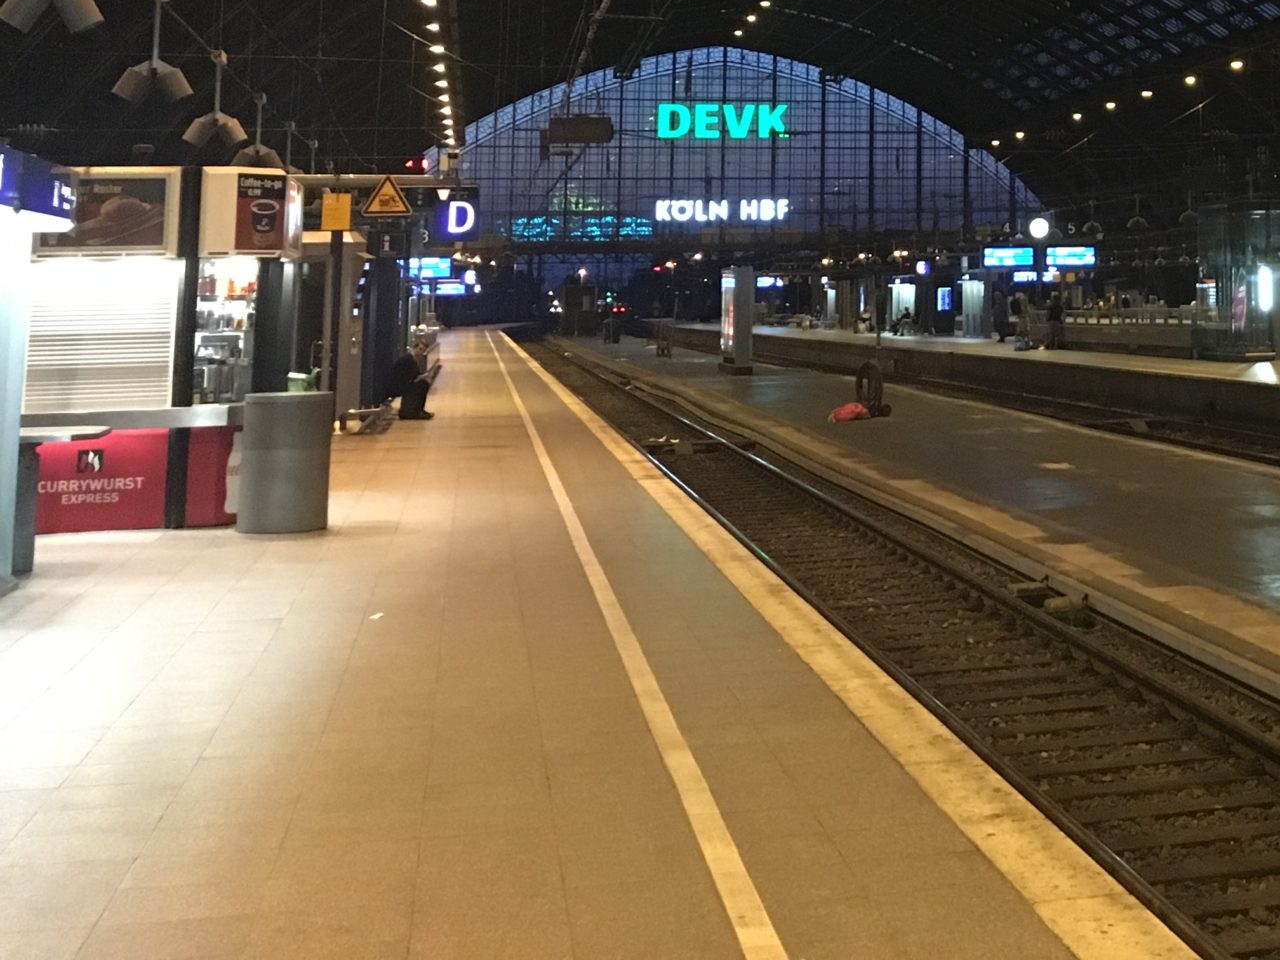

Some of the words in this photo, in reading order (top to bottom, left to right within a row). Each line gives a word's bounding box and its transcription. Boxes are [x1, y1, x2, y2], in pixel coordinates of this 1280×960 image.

[657, 103, 788, 138] DEVK
[447, 201, 475, 234] D
[655, 199, 729, 221] KÖLN
[740, 198, 789, 221] HBF
[1002, 222, 1010, 233] 4
[1067, 223, 1076, 234] 5
[420, 229, 429, 244] 3
[37, 477, 145, 494] CURRYWURST
[61, 492, 119, 505] EXPRESS
